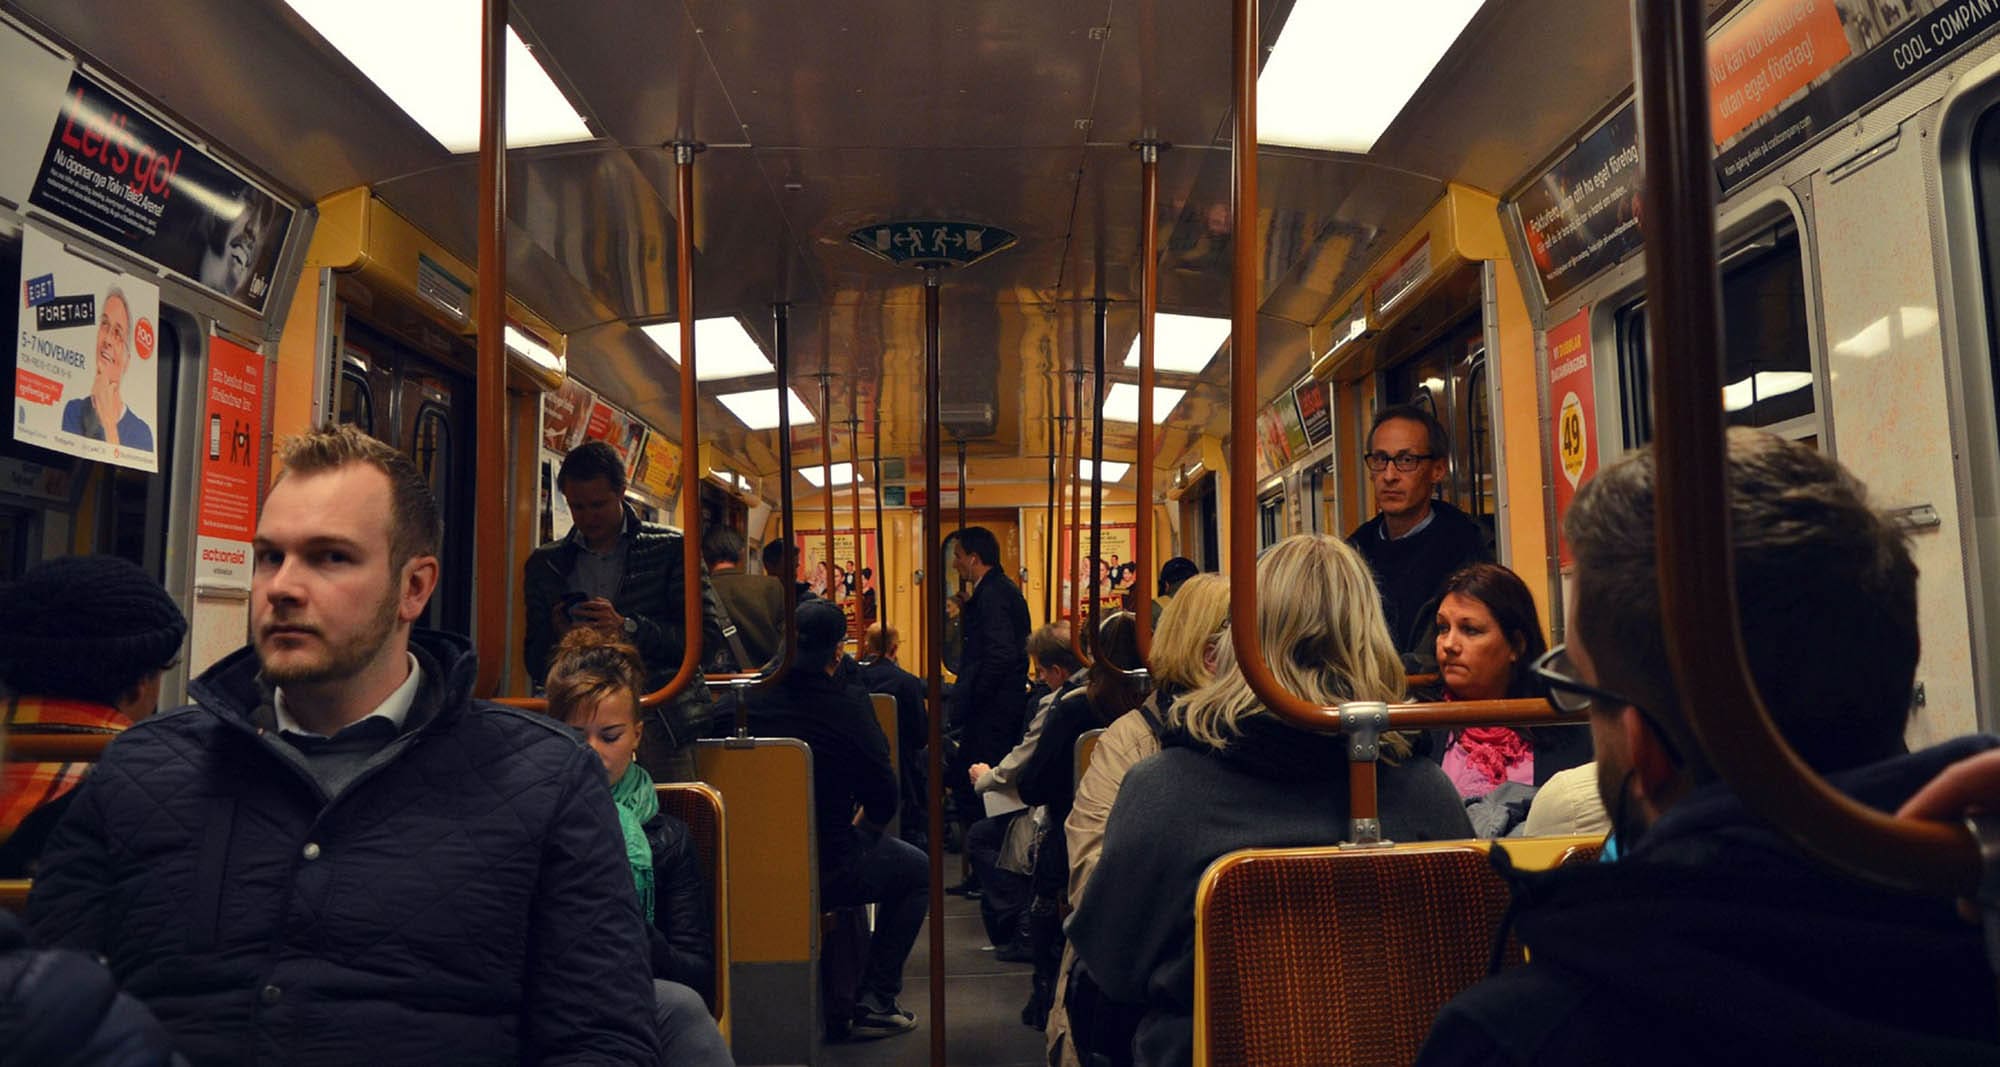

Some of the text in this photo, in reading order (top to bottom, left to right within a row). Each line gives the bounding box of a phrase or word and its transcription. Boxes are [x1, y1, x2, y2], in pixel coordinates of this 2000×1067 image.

[1711, 63, 1728, 87] Nu
[1723, 51, 1748, 75] kan
[1893, 34, 1932, 70] COOL
[1719, 31, 1816, 119] utan eget företag!
[61, 87, 130, 174] Let's
[129, 147, 183, 199] go!
[28, 280, 53, 301] EGET
[39, 301, 94, 322] FÖRETAG!
[37, 338, 86, 370] NOVEMBER
[1563, 413, 1580, 457] 49
[202, 548, 245, 565] actionaid
